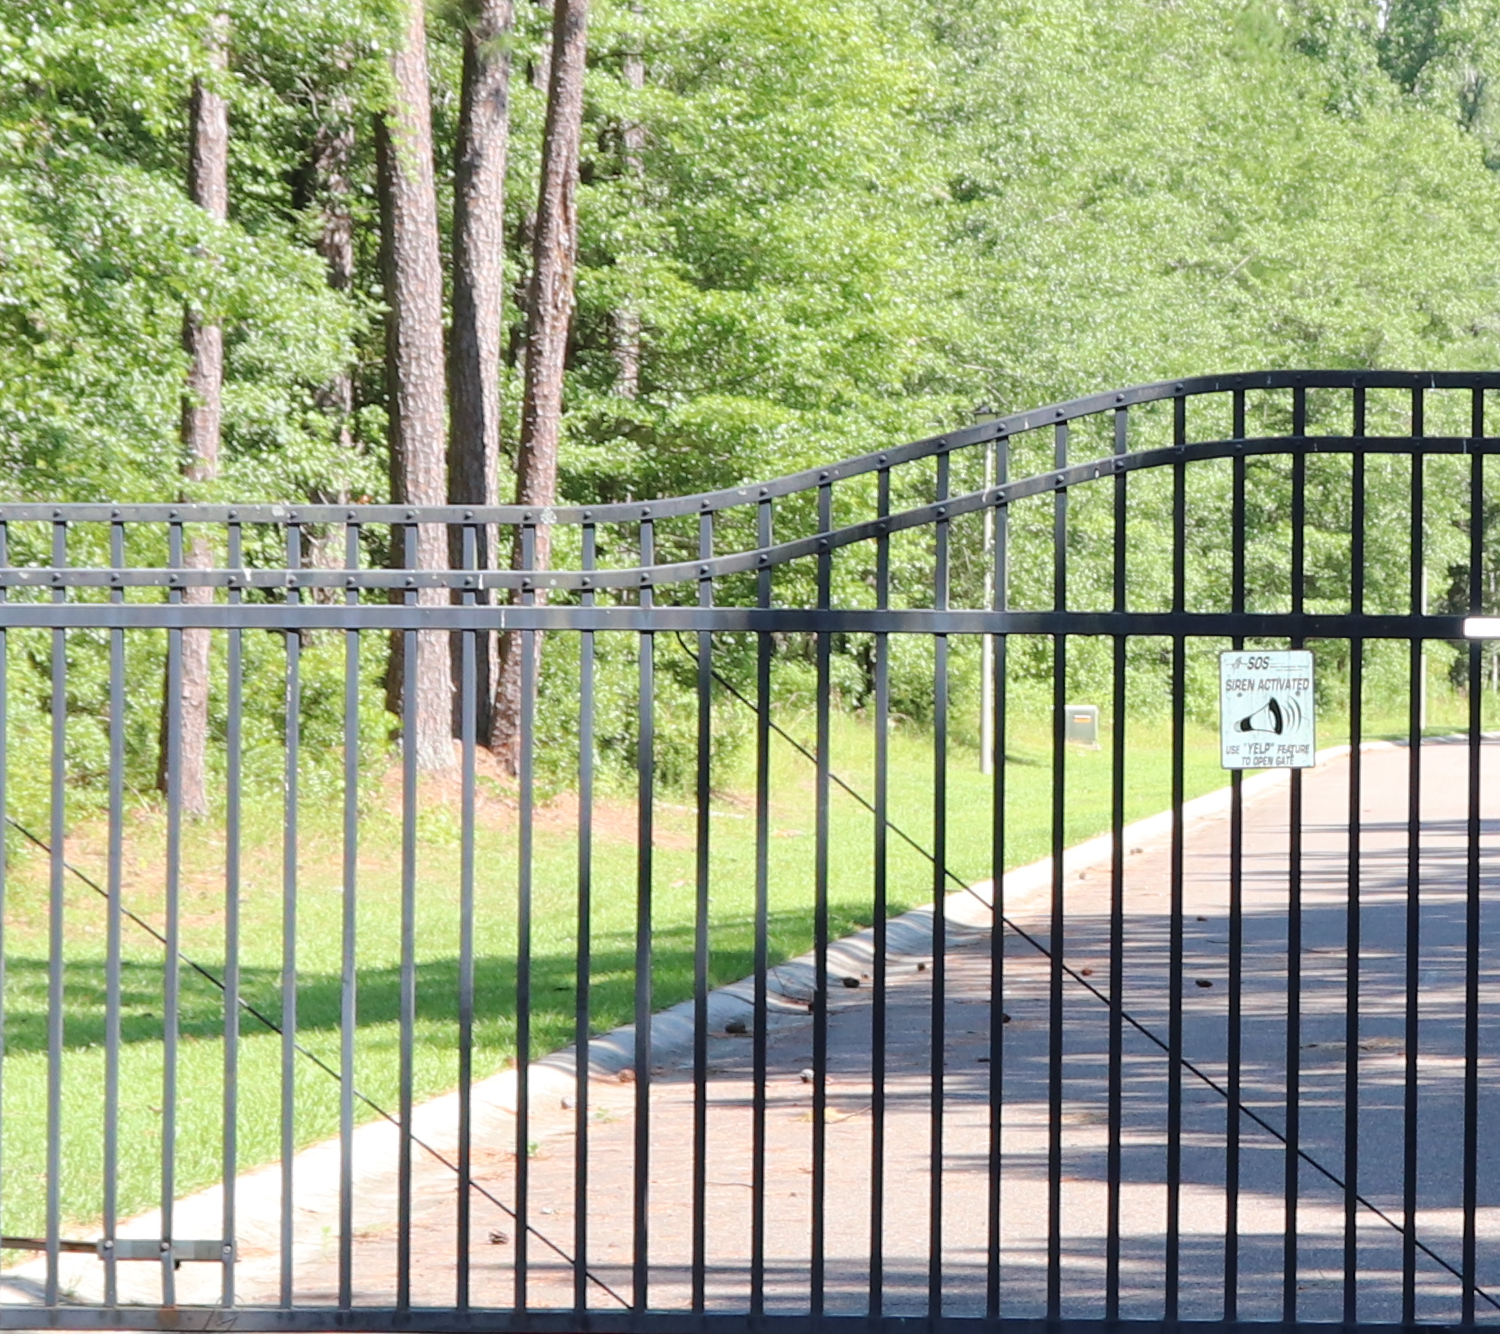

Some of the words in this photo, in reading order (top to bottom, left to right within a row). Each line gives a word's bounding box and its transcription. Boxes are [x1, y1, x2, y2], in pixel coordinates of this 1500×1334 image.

[1247, 656, 1270, 670] SOS
[1225, 678, 1255, 691] SIREN
[1257, 677, 1310, 691] ACTIVATED
[1226, 745, 1240, 754] USE
[1243, 743, 1275, 754] "YELP"
[1277, 744, 1310, 754] FEATURE
[1242, 756, 1251, 766] TO
[1253, 756, 1274, 766] OPEN
[1275, 756, 1294, 766] GATE
